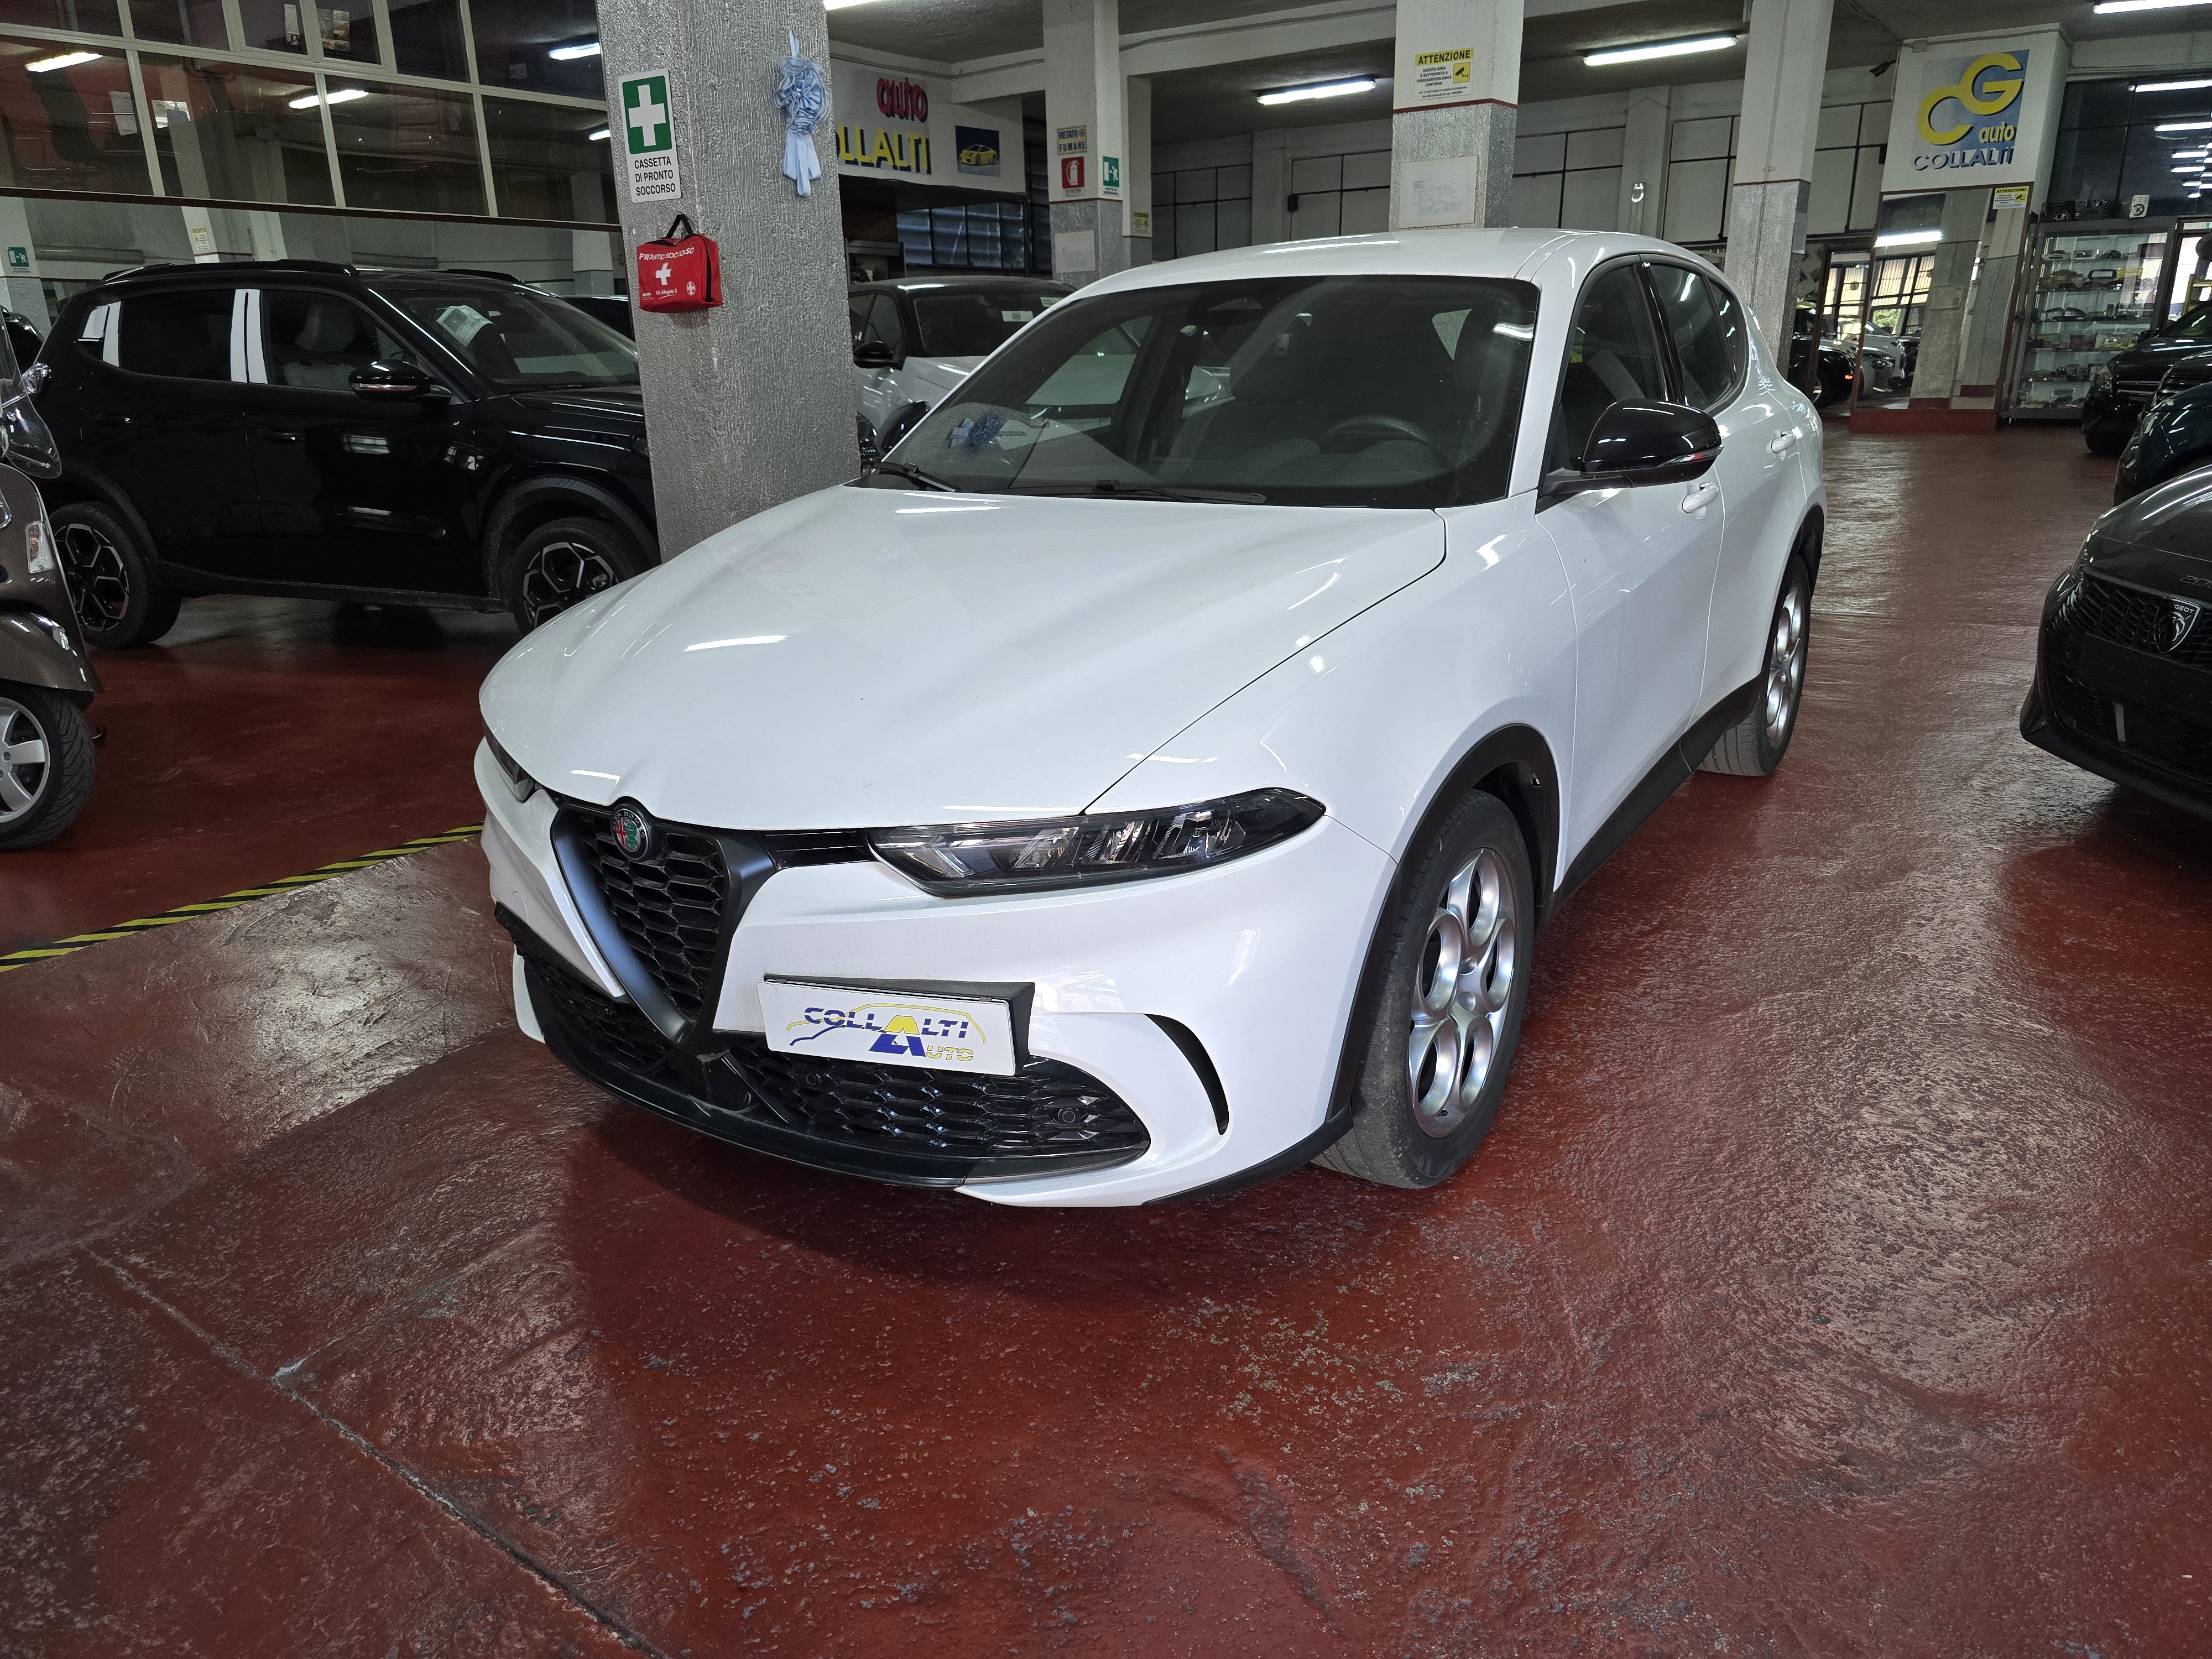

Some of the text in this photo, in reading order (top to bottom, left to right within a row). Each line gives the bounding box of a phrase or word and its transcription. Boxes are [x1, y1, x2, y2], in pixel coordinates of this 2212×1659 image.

[1418, 50, 1470, 65] ATTENZIONE
[877, 77, 928, 123] auto
[1979, 121, 2017, 143] auto
[835, 122, 932, 174] LLALTI
[1059, 141, 1086, 152] FUMARE
[634, 156, 671, 169] CASSETTA
[1913, 147, 2014, 171] COLLALTI
[635, 169, 673, 182] DI PRONTO
[636, 182, 676, 196] SOCCORSO
[665, 247, 695, 259] SOCOSO
[2179, 575, 2212, 588] 20
[624, 811, 645, 838] ROMEO
[804, 1007, 969, 1057] COLLALTI
